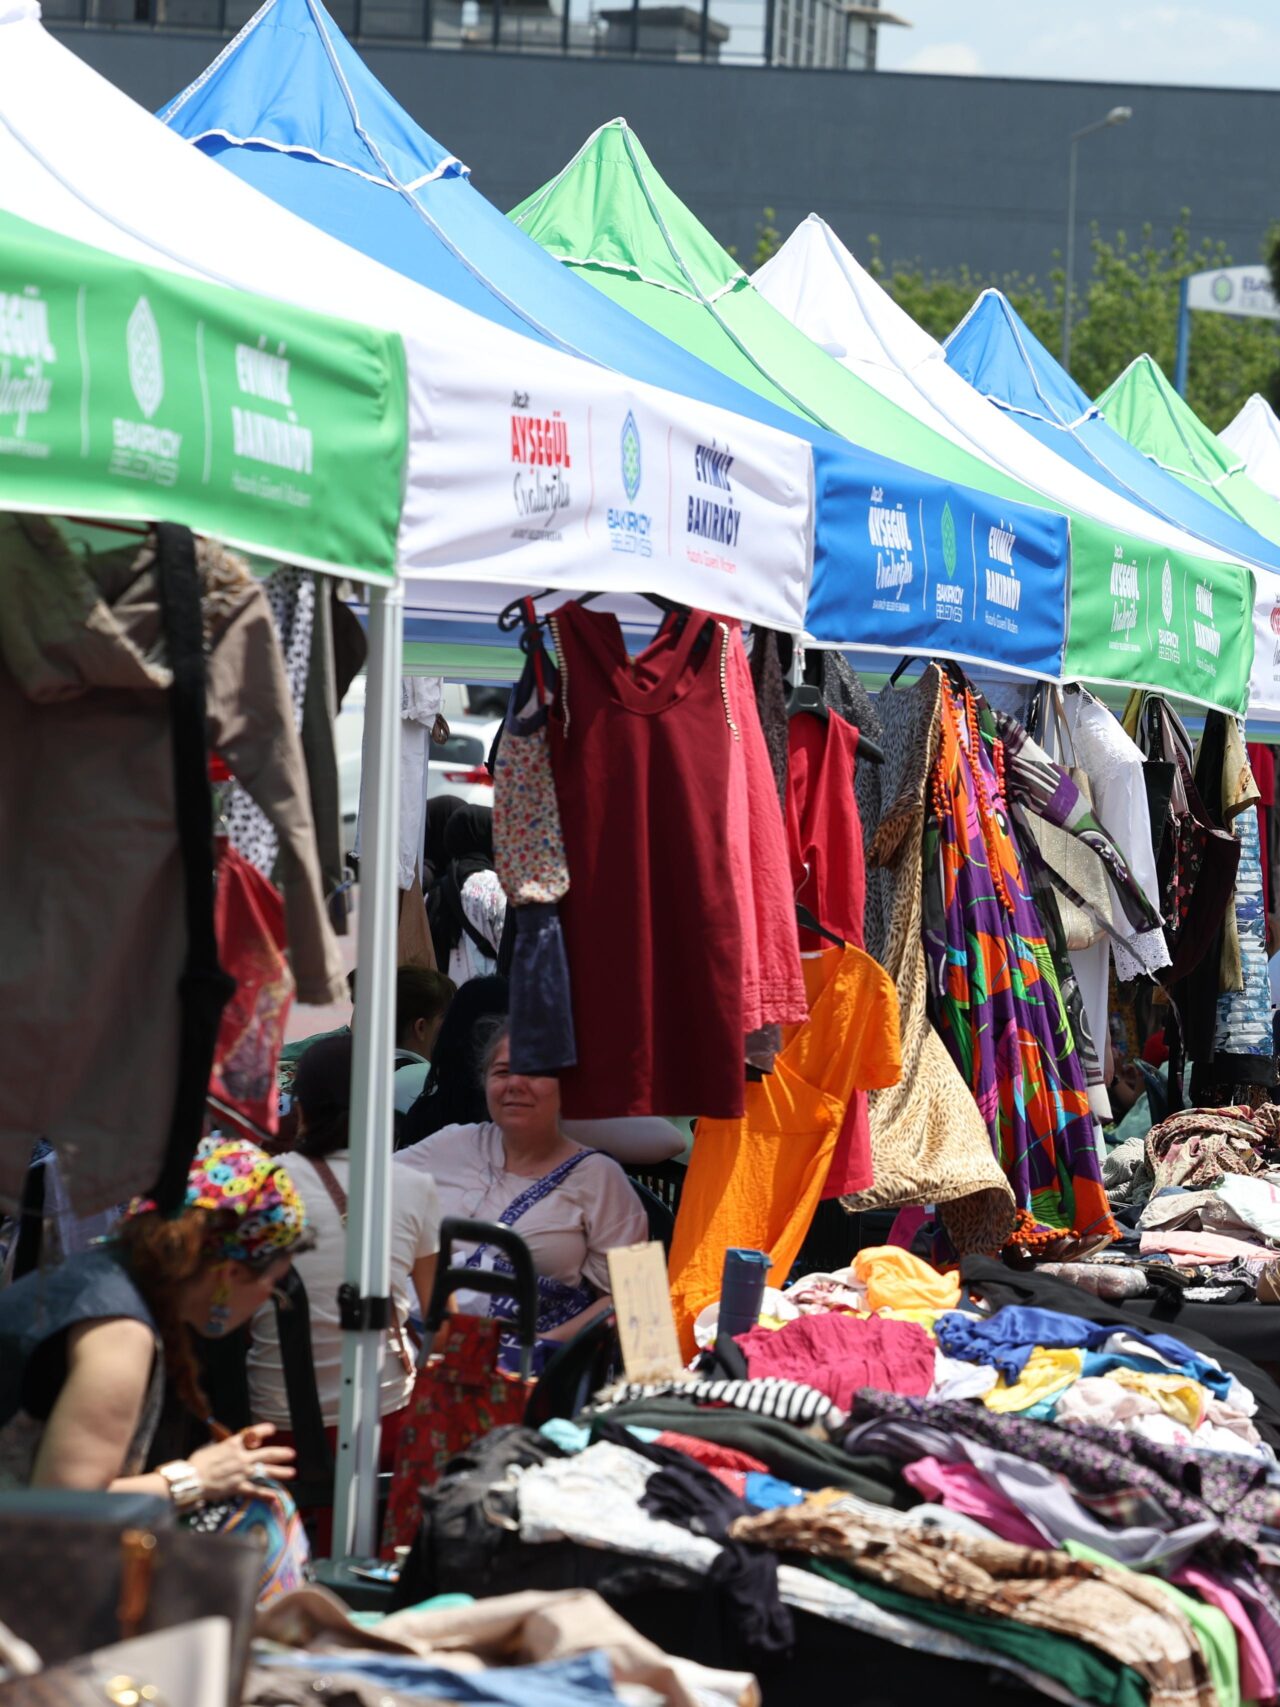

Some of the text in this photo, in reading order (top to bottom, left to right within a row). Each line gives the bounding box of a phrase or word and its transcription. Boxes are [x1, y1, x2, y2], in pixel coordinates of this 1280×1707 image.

[511, 411, 571, 474] AYŞEGÜL
[687, 496, 741, 547] BAKIRKÖY
[985, 568, 1021, 611] BAKIRKÖY
